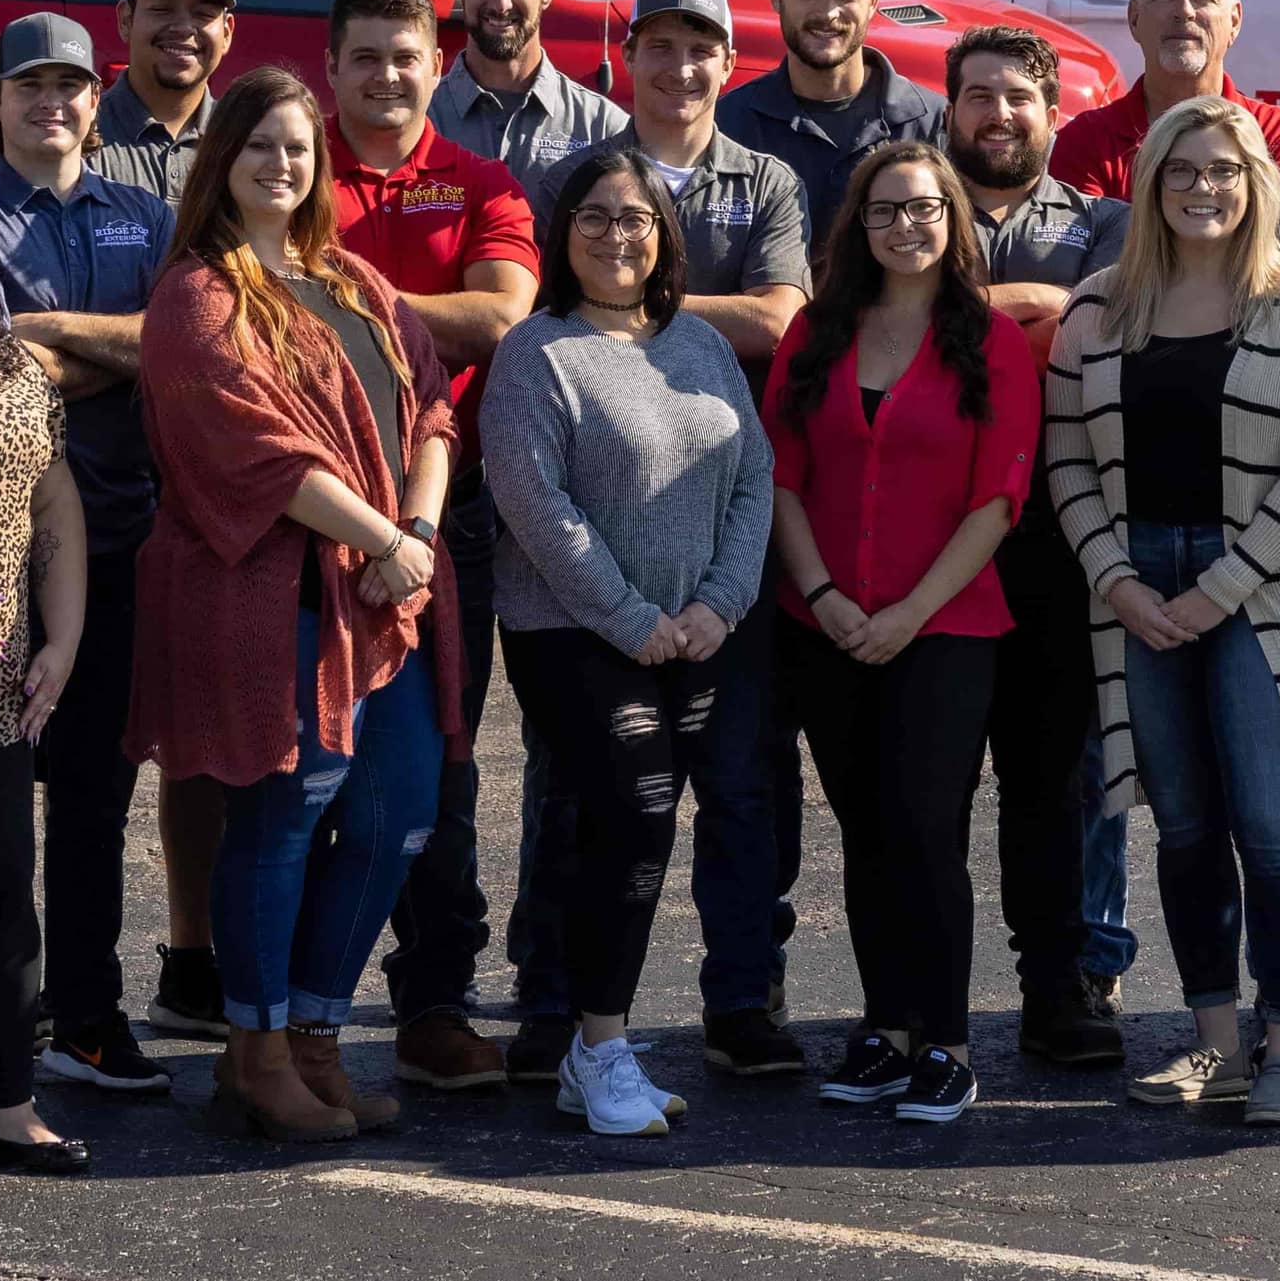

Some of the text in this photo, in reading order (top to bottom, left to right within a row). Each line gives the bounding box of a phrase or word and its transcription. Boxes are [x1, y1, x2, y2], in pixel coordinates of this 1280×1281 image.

[402, 186, 465, 200] RIDGE TOP
[402, 194, 465, 206] EXTERIORS
[94, 227, 130, 237] RIDGE
[1033, 225, 1070, 234] RIDGE
